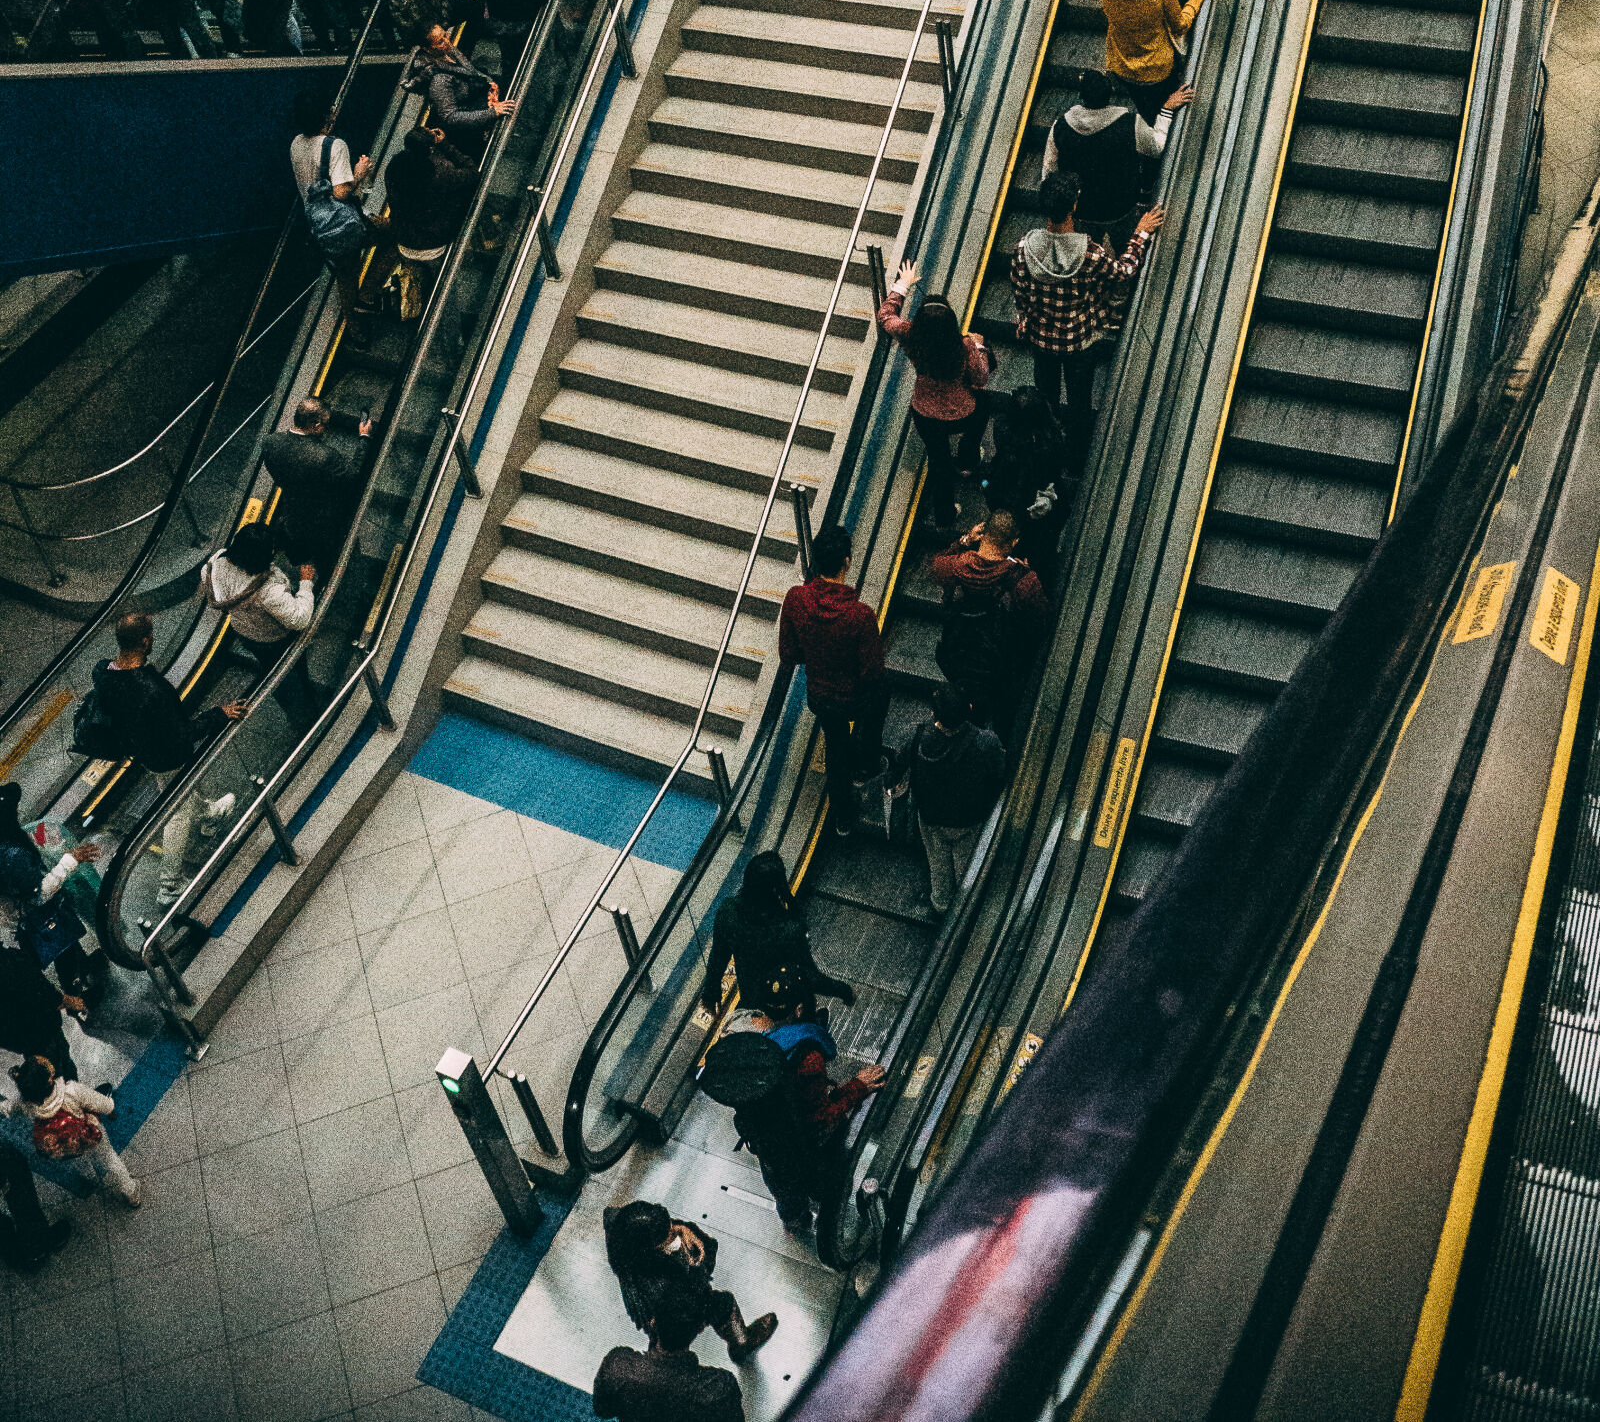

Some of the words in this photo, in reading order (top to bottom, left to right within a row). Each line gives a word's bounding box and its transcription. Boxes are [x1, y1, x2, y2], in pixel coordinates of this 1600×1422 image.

[1100, 813, 1113, 838] Deixe
[1110, 766, 1124, 805] esquerda
[1119, 746, 1130, 766] livre
